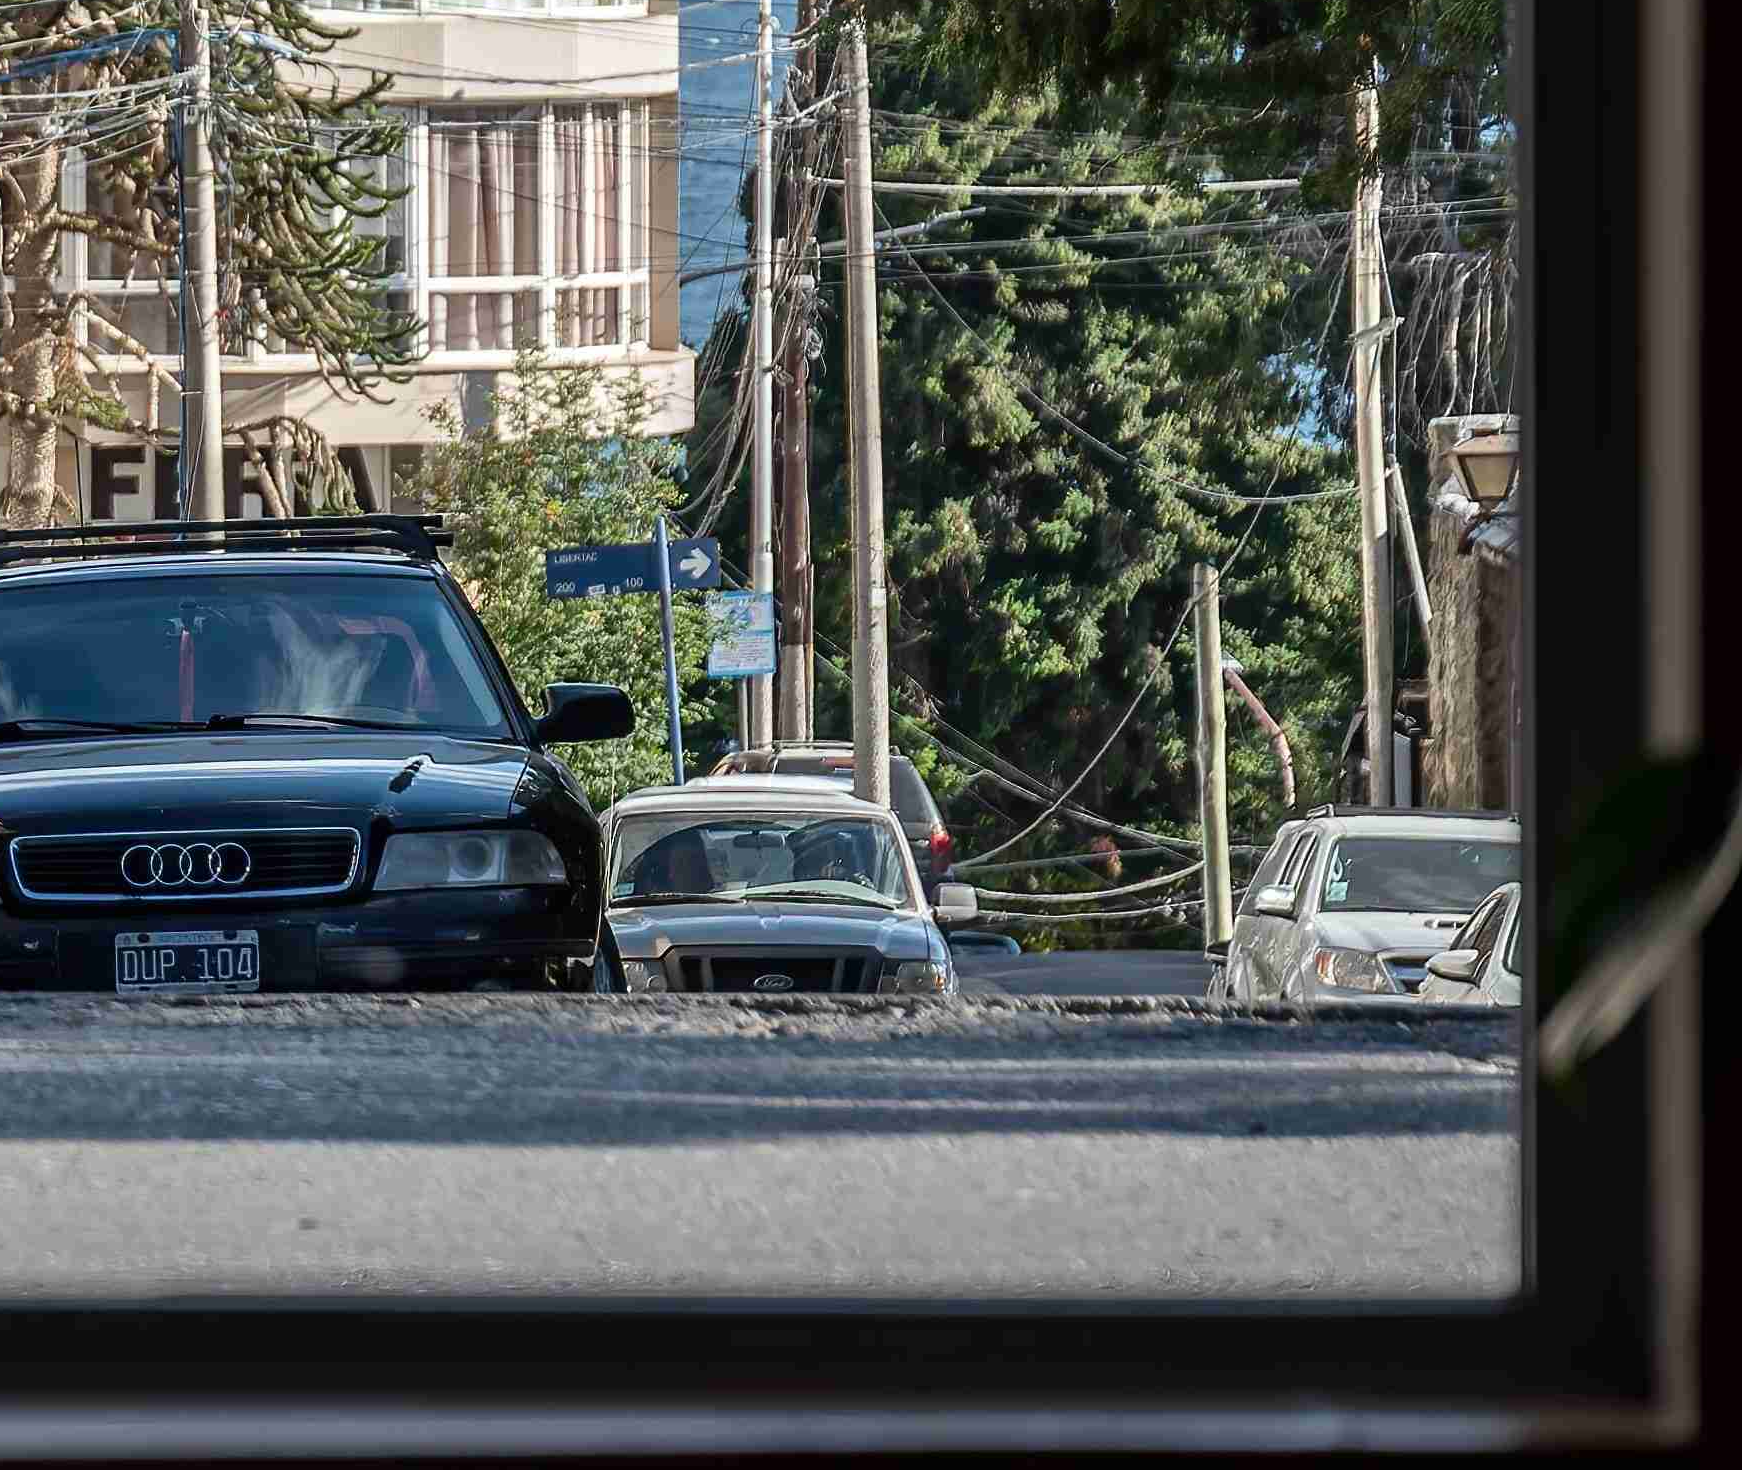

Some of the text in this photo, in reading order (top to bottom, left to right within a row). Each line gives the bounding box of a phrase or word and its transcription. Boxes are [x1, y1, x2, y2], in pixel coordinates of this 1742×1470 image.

[555, 582, 576, 594] 200
[626, 577, 644, 587] 100
[122, 947, 252, 982] DUP 104
